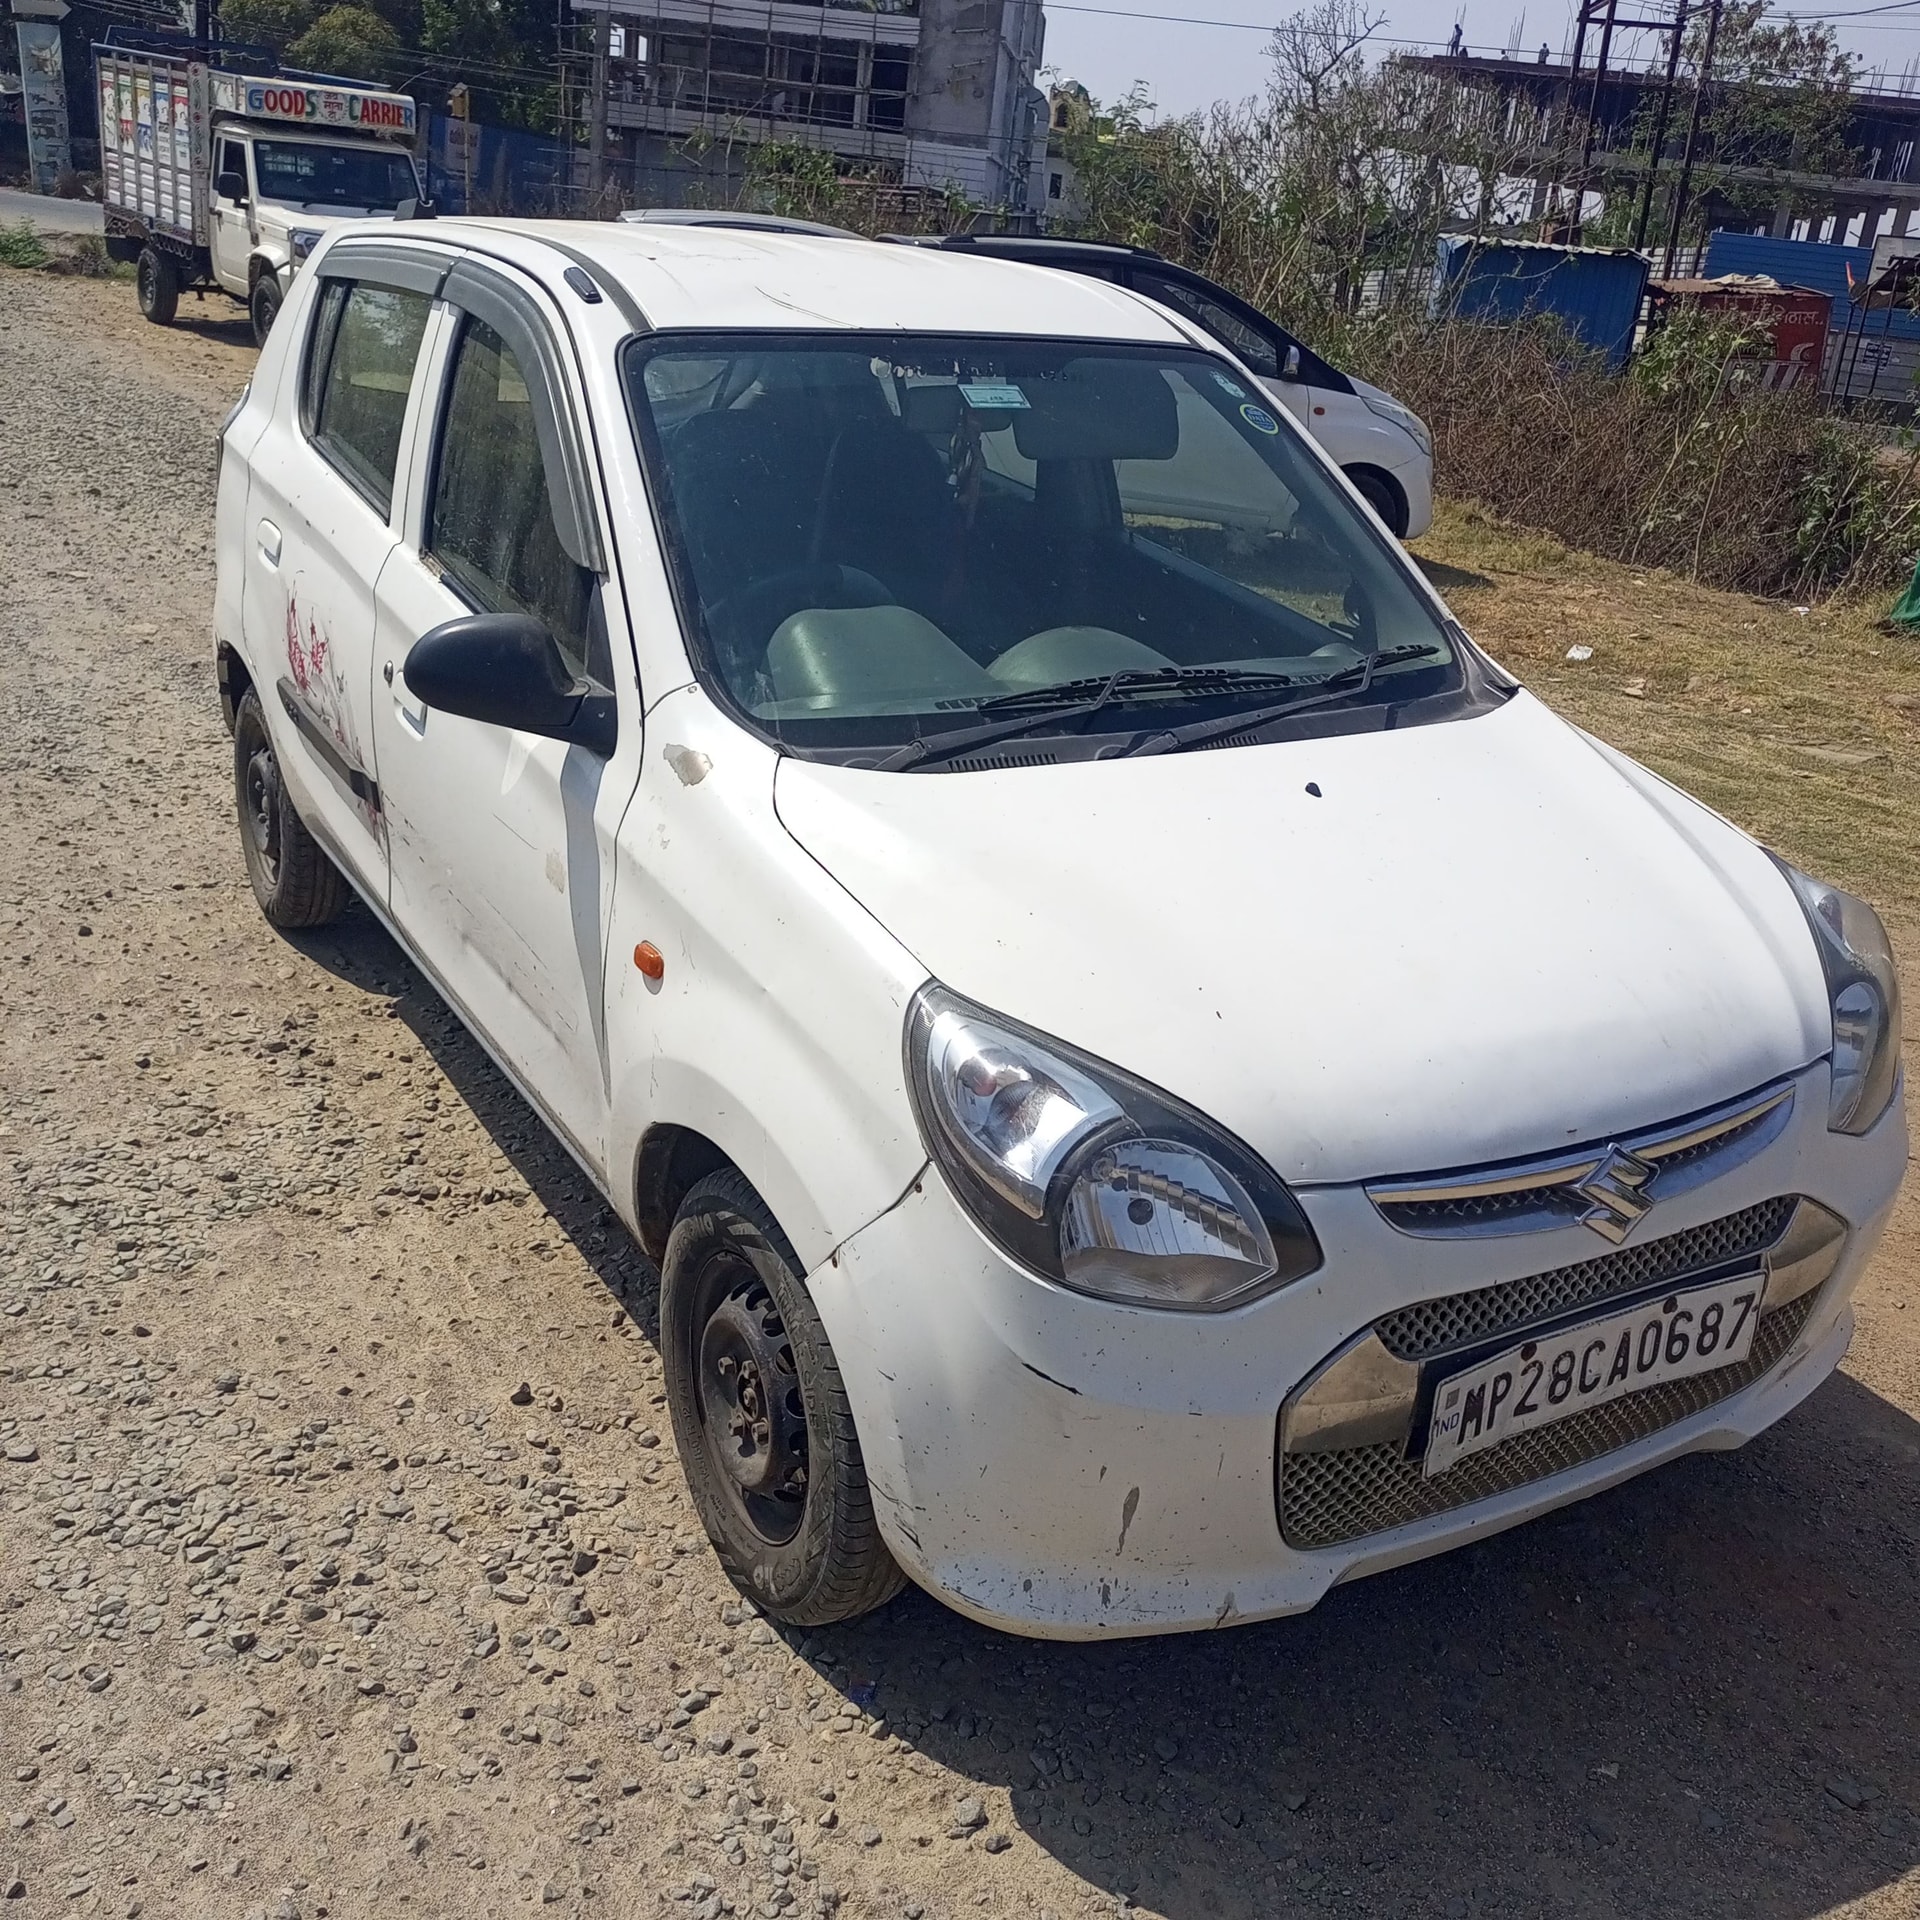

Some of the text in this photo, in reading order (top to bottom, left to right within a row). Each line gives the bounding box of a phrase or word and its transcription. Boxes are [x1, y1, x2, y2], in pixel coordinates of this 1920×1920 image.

[248, 88, 413, 129] GOODS CARRIER
[1456, 1293, 1756, 1445] MP28CA0687
[1434, 1410, 1461, 1439] IND
